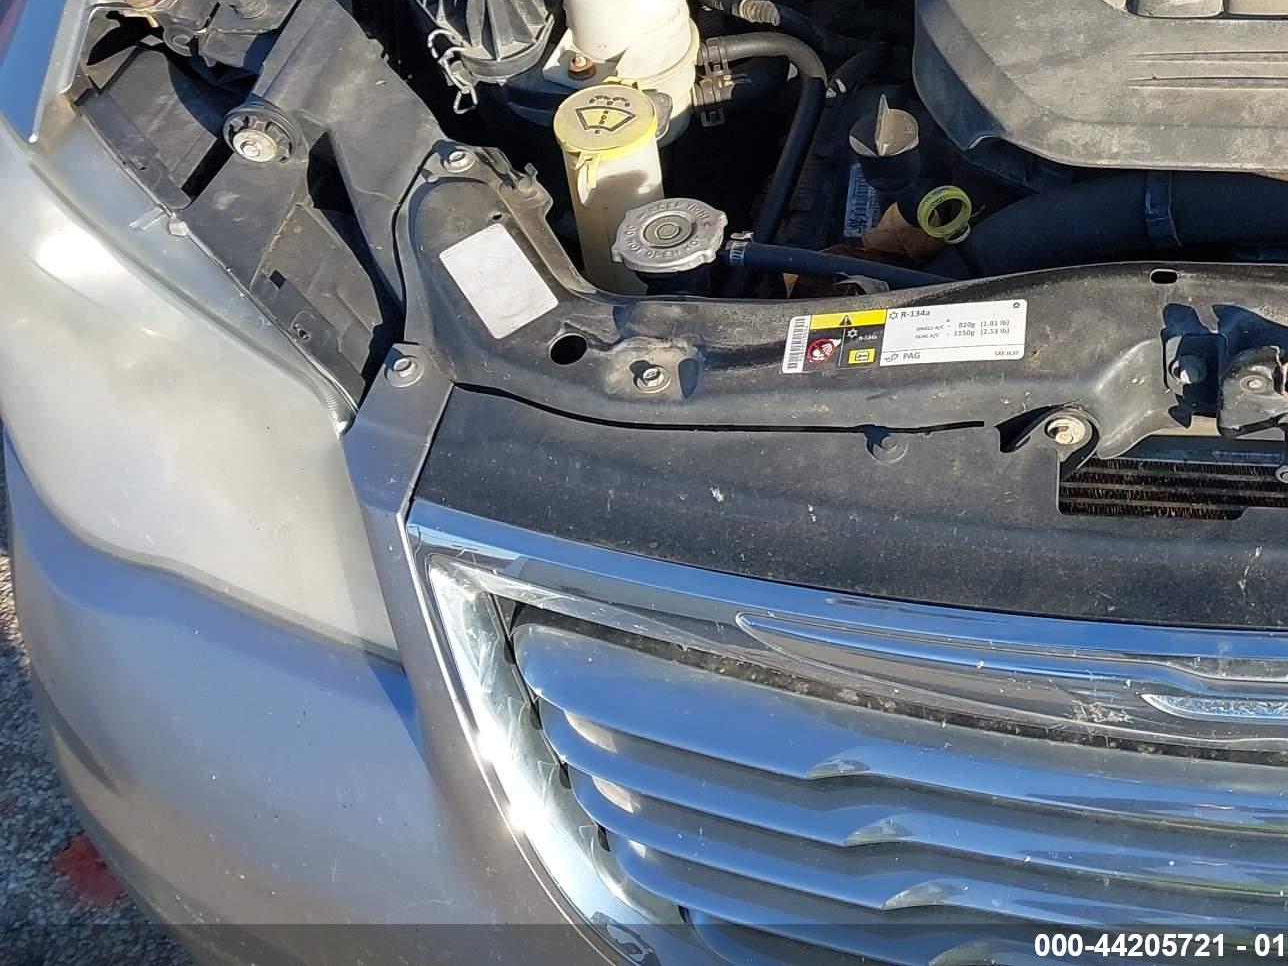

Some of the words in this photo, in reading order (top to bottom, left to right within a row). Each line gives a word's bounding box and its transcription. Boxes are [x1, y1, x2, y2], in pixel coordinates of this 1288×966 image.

[644, 249, 678, 258] OPEN
[901, 309, 931, 320] R-134a
[958, 321, 976, 329] 820g
[953, 329, 975, 338] 1150g
[903, 352, 921, 360] PAG
